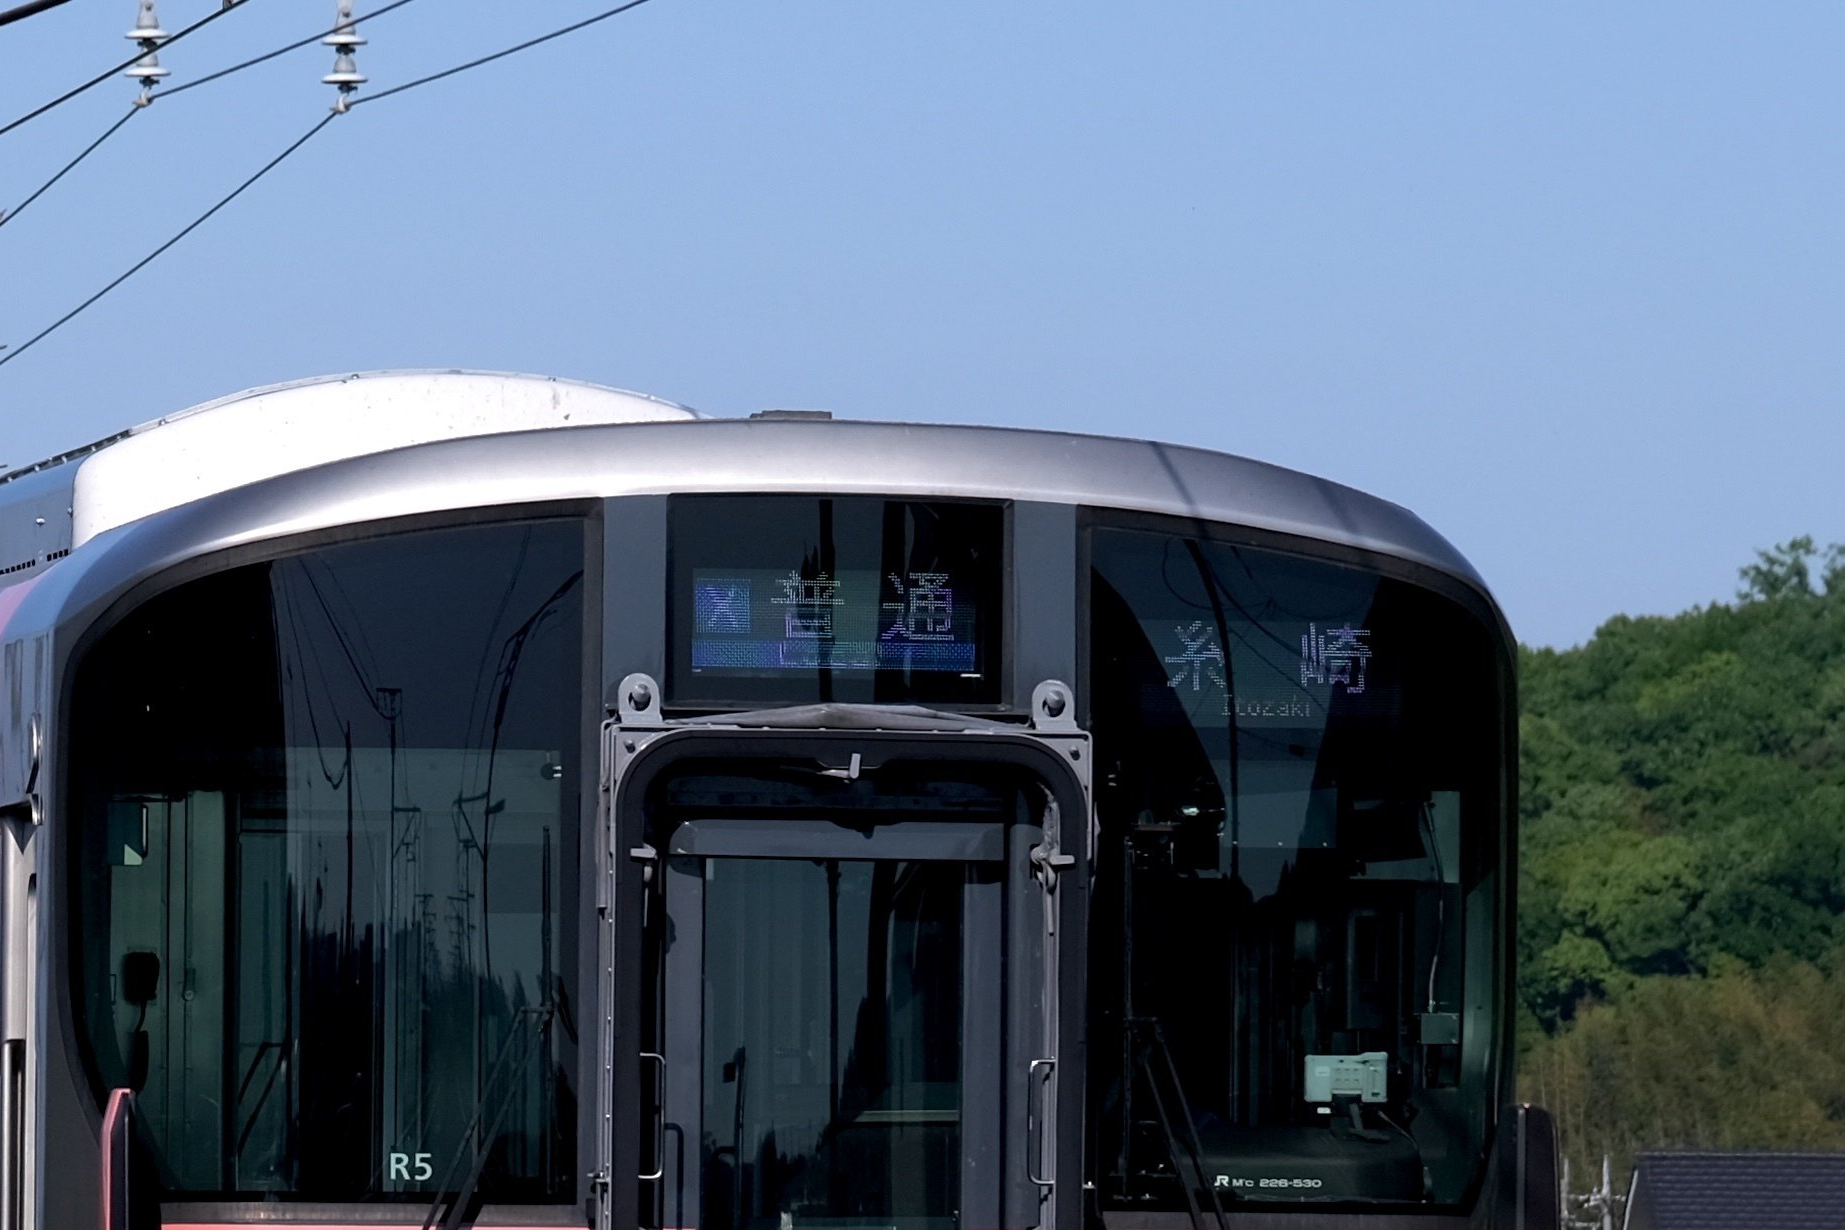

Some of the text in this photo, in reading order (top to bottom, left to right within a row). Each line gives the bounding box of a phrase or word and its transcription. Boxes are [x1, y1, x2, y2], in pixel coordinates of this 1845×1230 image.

[771, 570, 955, 640] 普通
[1165, 620, 1372, 693] 糸崎
[390, 1152, 433, 1181] R5
[1214, 1175, 1230, 1187] JR
[1259, 1178, 1322, 1188] 226-530
